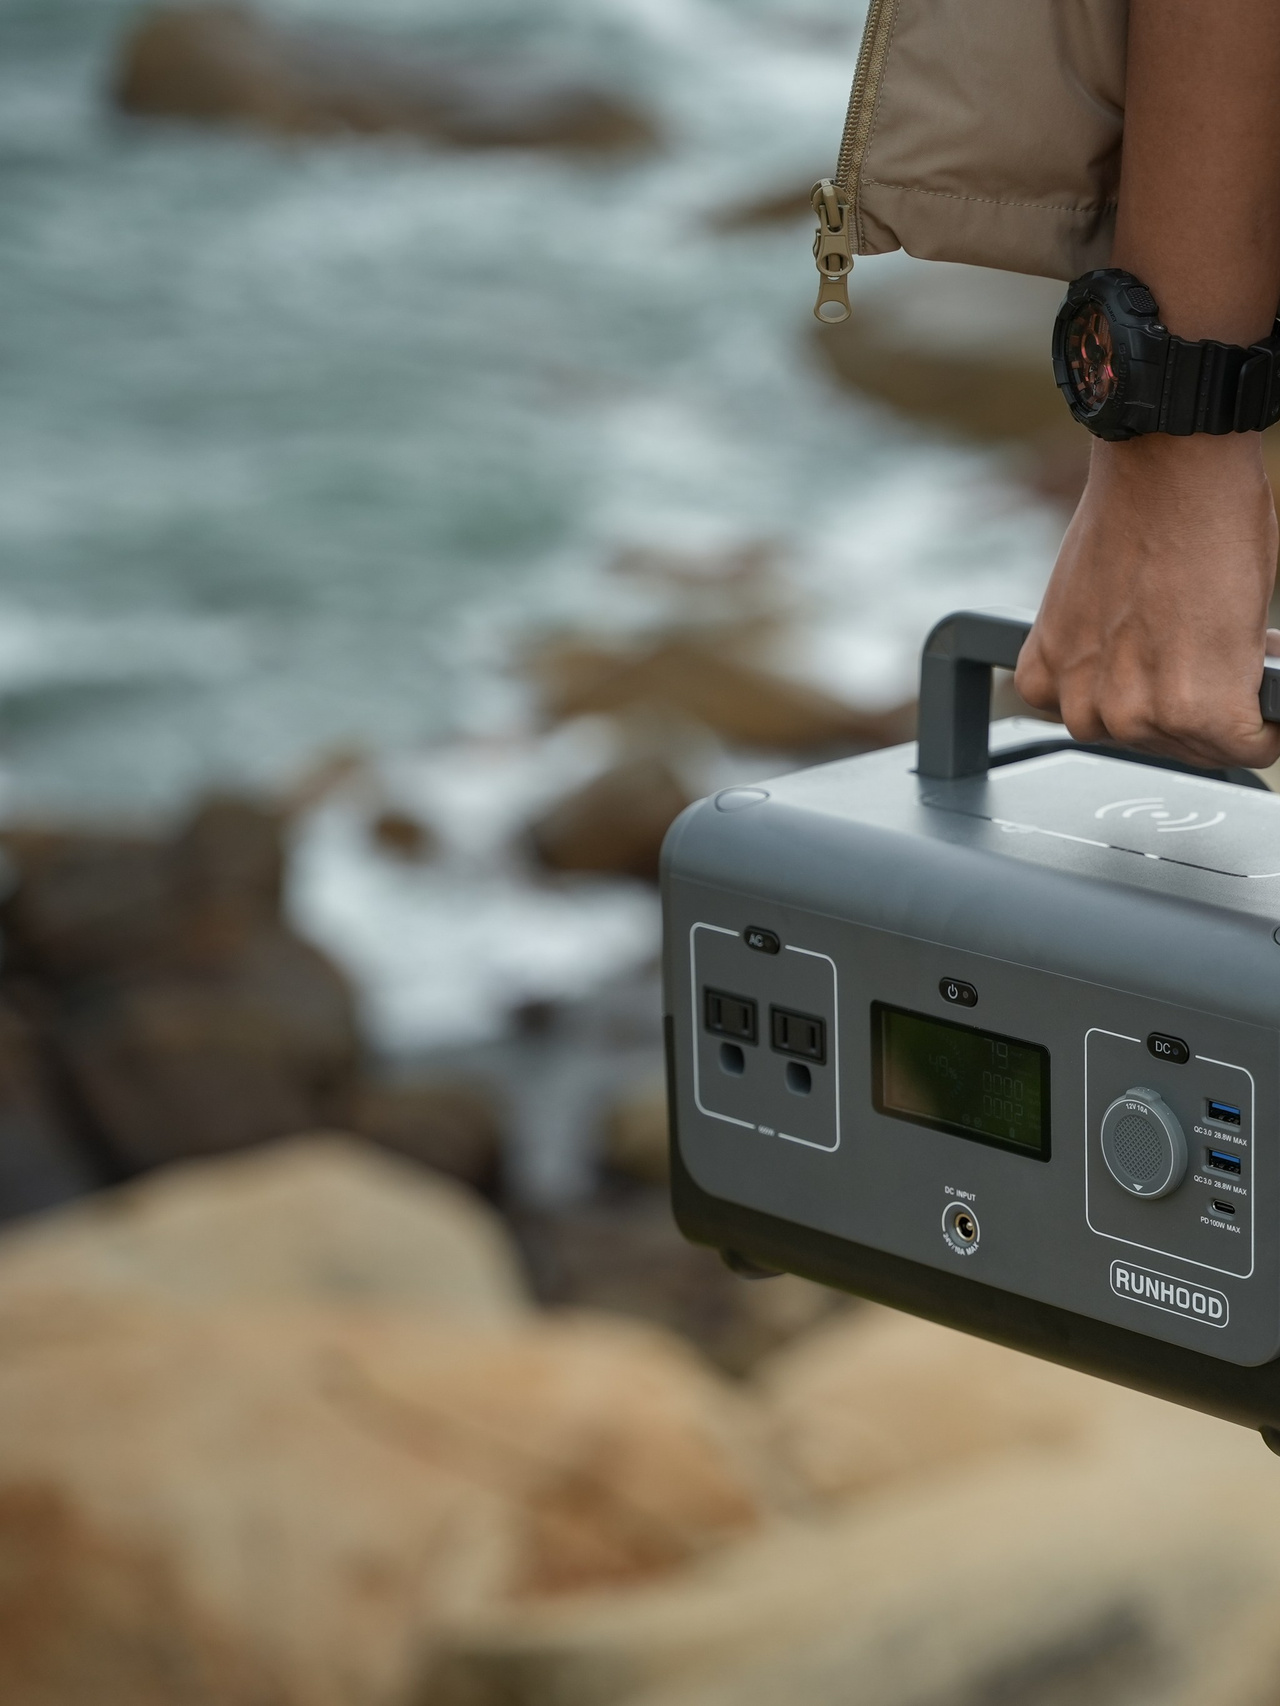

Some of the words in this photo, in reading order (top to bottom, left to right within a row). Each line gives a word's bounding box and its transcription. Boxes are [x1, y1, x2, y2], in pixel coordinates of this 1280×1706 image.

[749, 933, 763, 947] AC
[1155, 1040, 1171, 1055] DC
[1232, 1136, 1248, 1147] MAX
[944, 1185, 955, 1196] DC
[956, 1189, 976, 1201] INPUT
[1232, 1185, 1248, 1196] MAX
[1226, 1223, 1241, 1234] MAX
[1116, 1267, 1223, 1319] RUNHOOD
